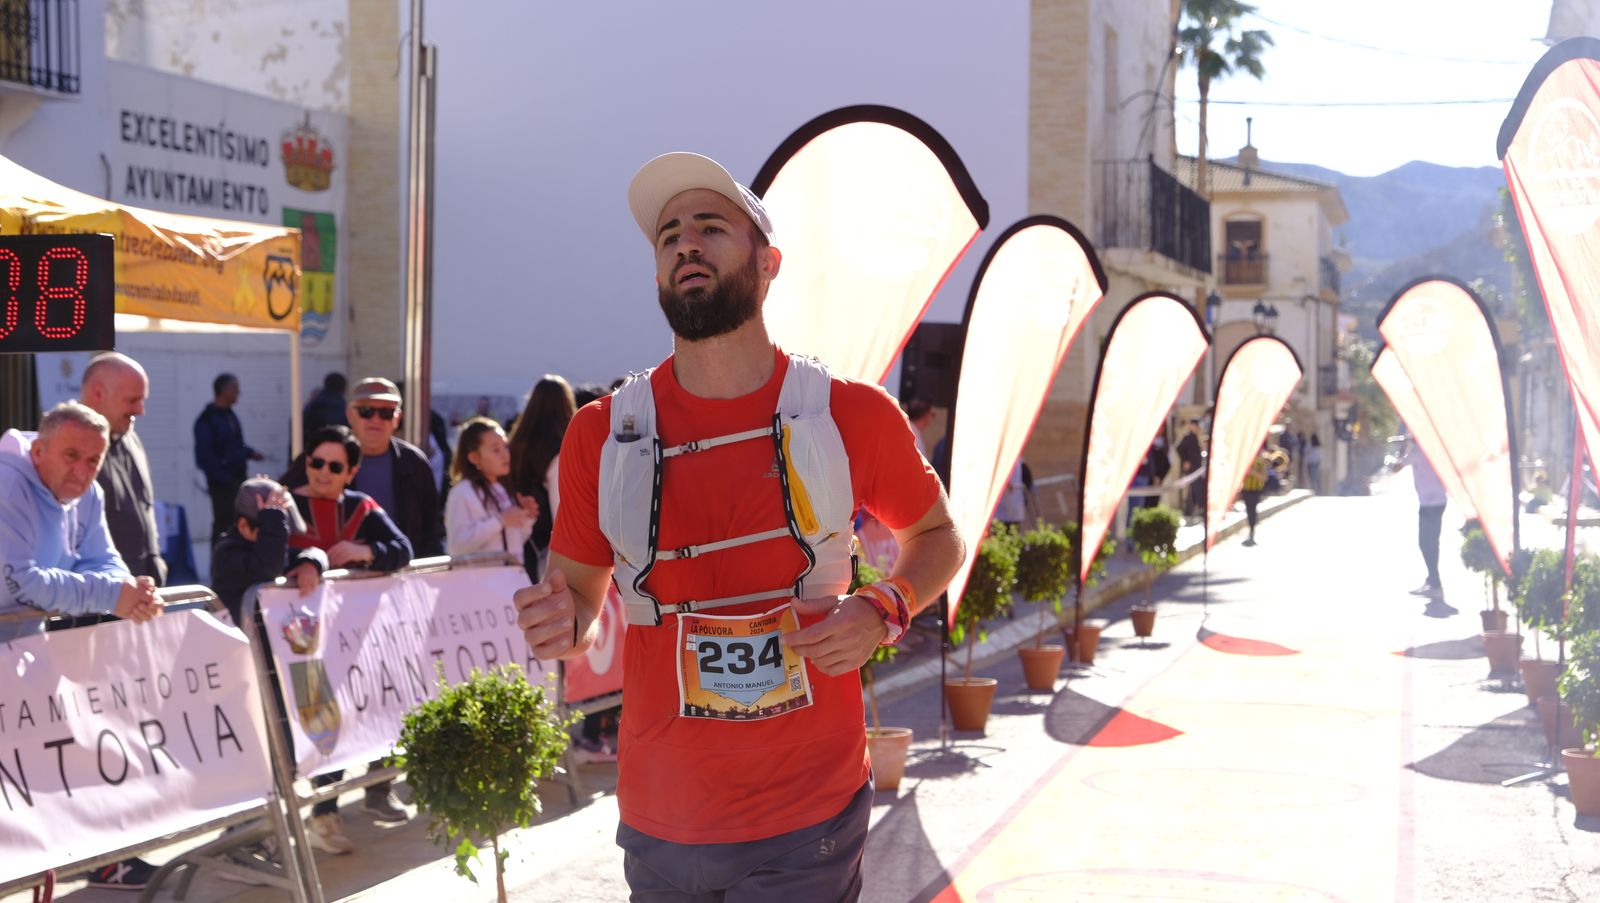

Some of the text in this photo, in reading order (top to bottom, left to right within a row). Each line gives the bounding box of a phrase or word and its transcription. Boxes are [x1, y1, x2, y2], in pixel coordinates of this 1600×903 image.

[120, 109, 270, 168] EXCELENTÍSIMO
[125, 164, 269, 216] AYUNTAMIENTO
[337, 607, 498, 653] AYUNTAMIENTO
[691, 624, 700, 634] LA
[749, 616, 777, 630] CANTORIA
[750, 628, 764, 636] 2024
[698, 636, 783, 675] 234
[184, 662, 221, 695] DE
[713, 680, 774, 690] ANTONIO MANUEL
